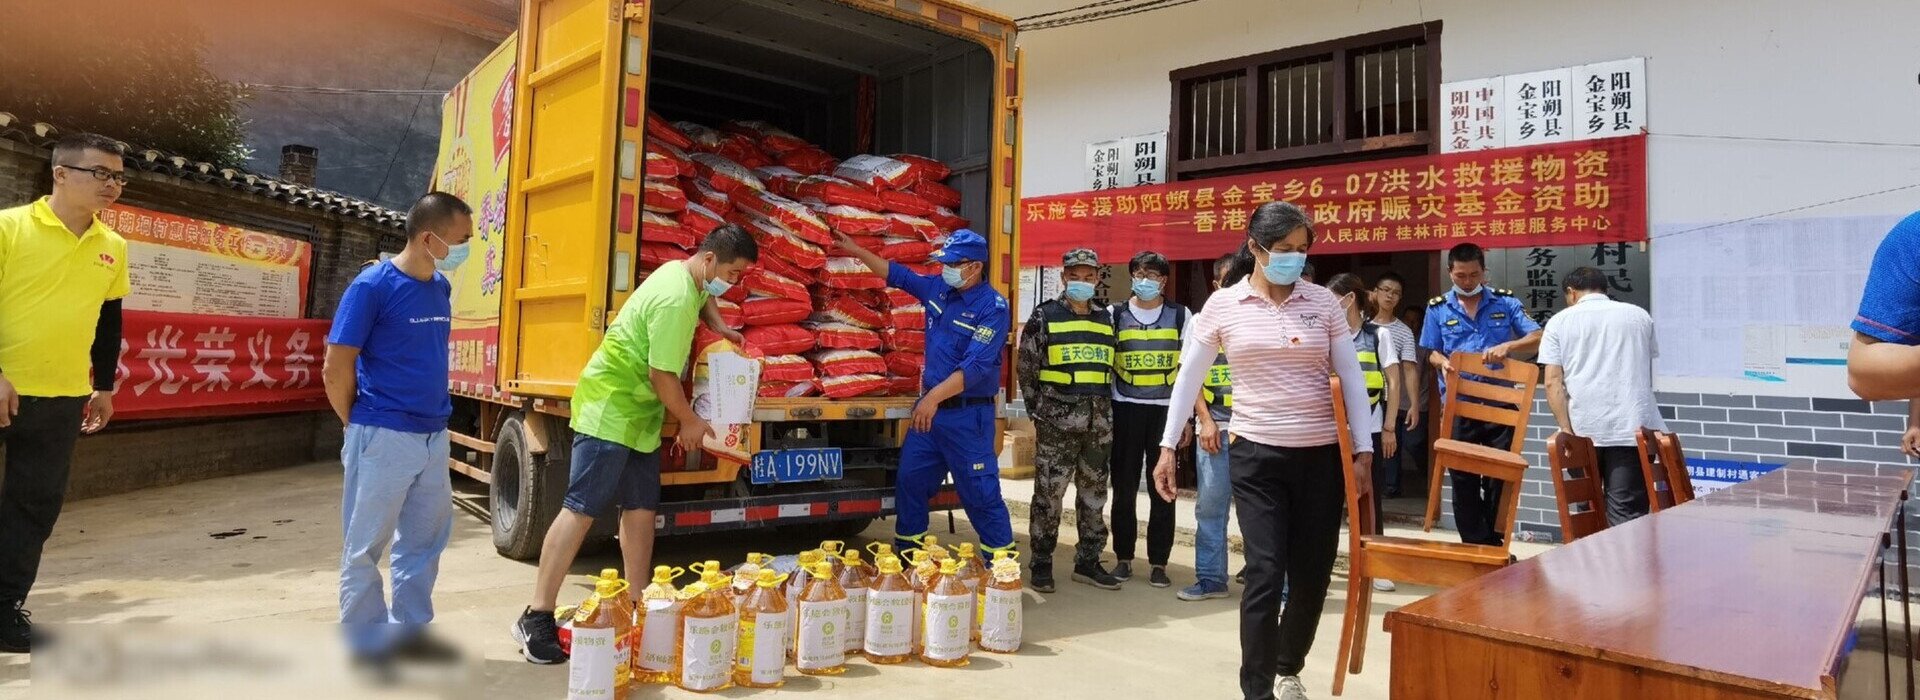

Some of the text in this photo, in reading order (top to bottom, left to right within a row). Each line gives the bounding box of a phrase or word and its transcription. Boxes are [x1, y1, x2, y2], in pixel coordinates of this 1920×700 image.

[1475, 88, 1495, 151] 中国共
[1517, 83, 1537, 140] 金宝乡
[1542, 80, 1561, 137] 阳朔县
[1586, 75, 1605, 134] 金宝乡
[1611, 72, 1632, 131] 阳朔县
[1026, 150, 1609, 222] 乐施会援助阳朔县金宝乡6.07洪水救援物资
[1093, 149, 1105, 191] 金宝乡
[1107, 148, 1119, 190] 阳朔县
[1135, 141, 1156, 187] 阳朔县
[1140, 181, 1609, 233] ——香港政府赈灾基金资助
[1314, 215, 1611, 243] 人民政府 桂林市蓝天救援服务中心
[1591, 241, 1633, 302] 村民
[112, 325, 329, 395] 光荣义务
[1060, 347, 1082, 361] 蓝天
[1124, 354, 1174, 369] 蓝天 救援
[1210, 368, 1232, 384] 蓝天
